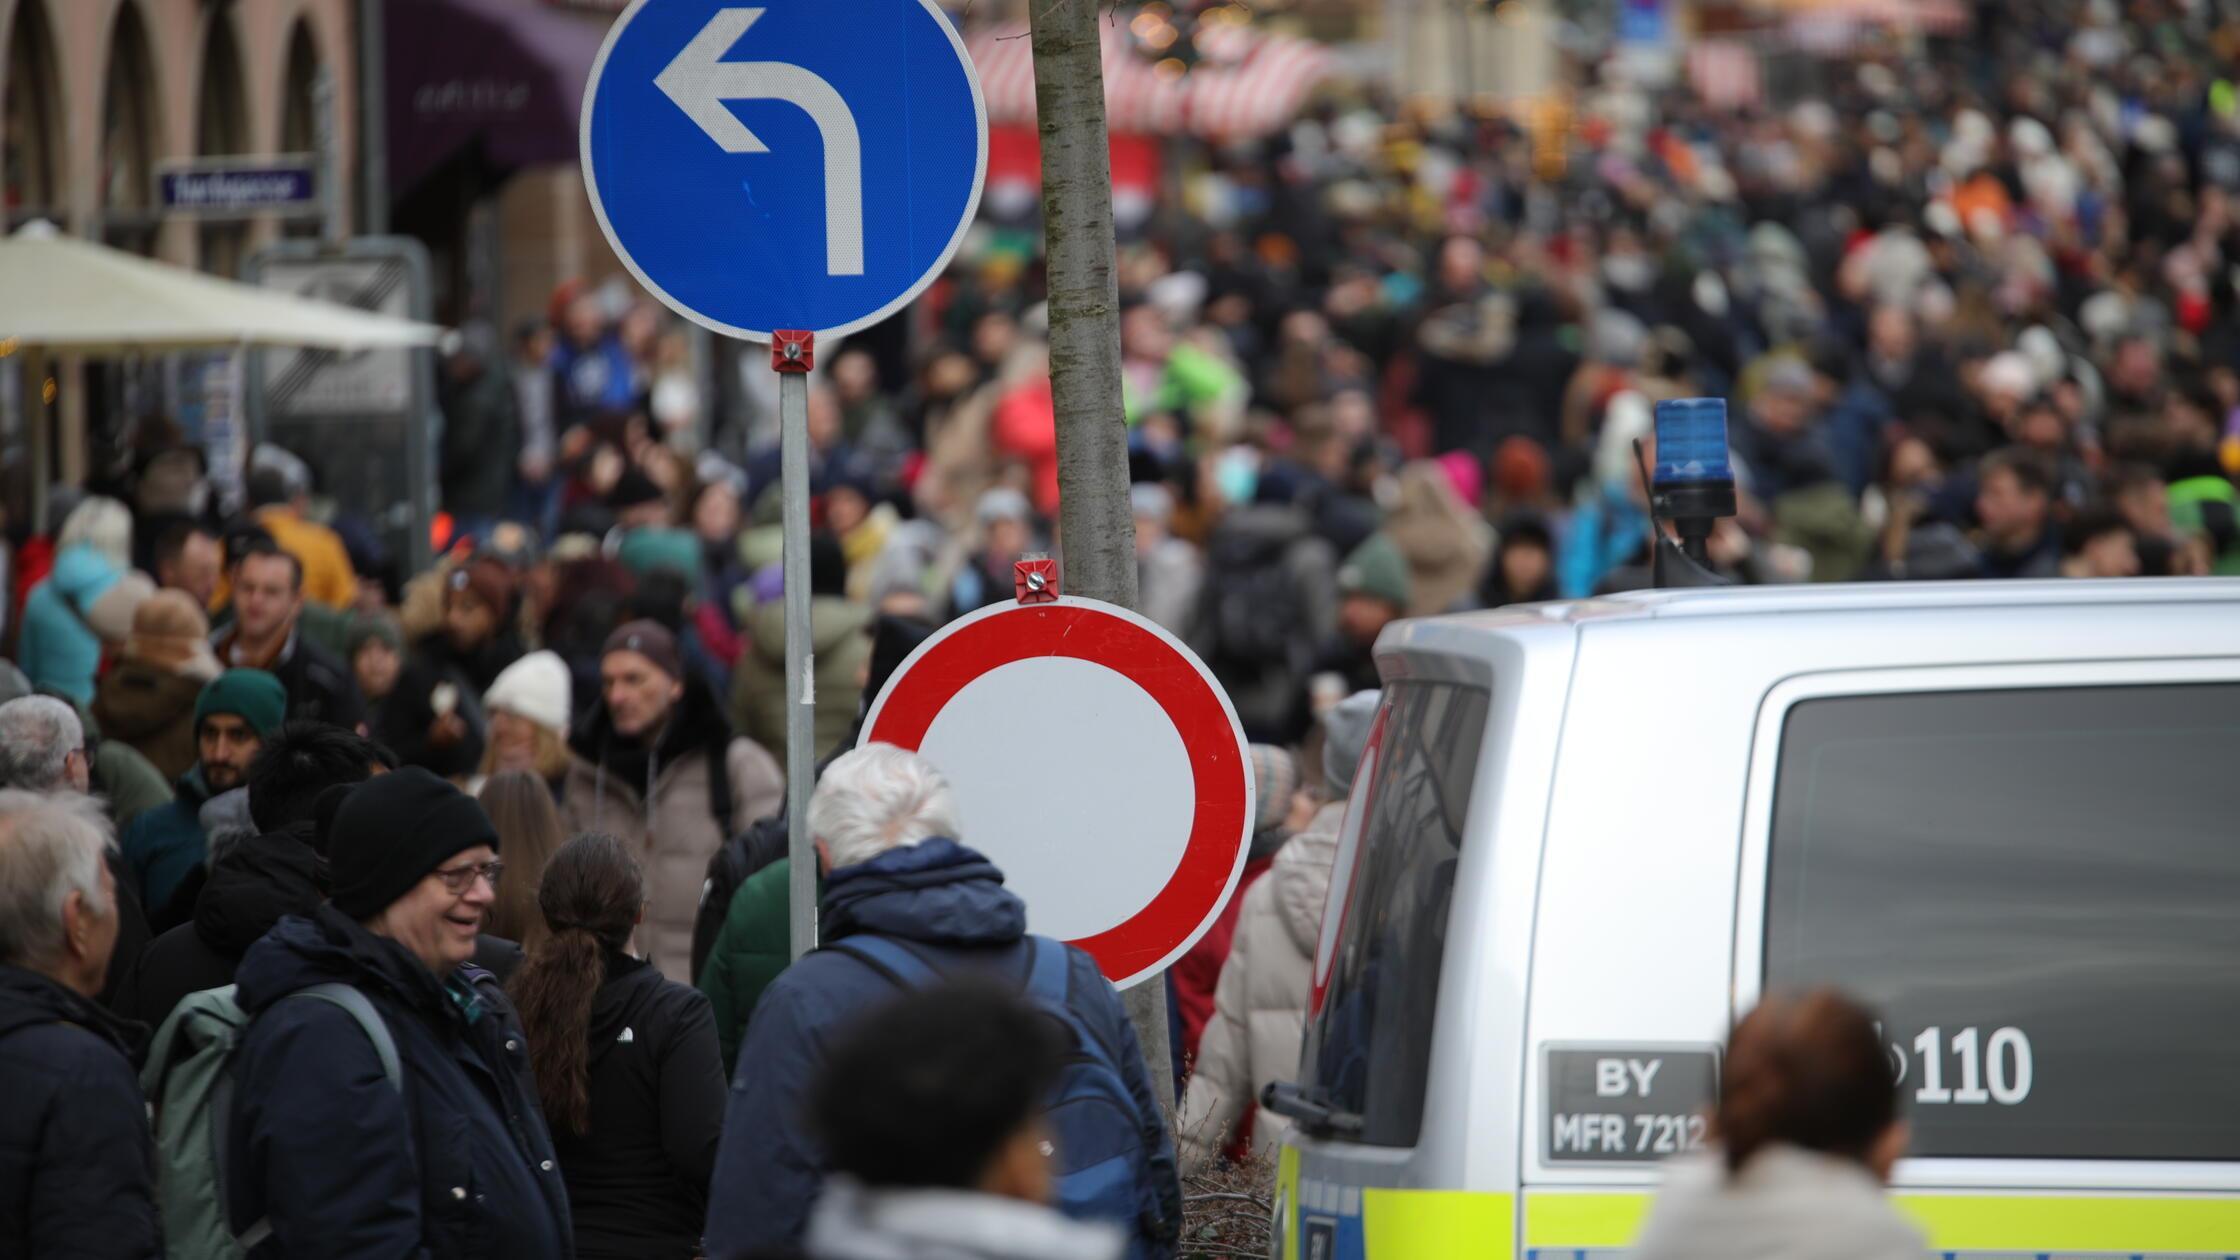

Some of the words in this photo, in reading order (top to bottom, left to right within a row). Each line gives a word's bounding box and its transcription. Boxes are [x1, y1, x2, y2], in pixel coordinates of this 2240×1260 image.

[1596, 1058, 1662, 1098] BY
[1914, 1026, 2033, 1105] 110
[1553, 1113, 1626, 1153] MFR
